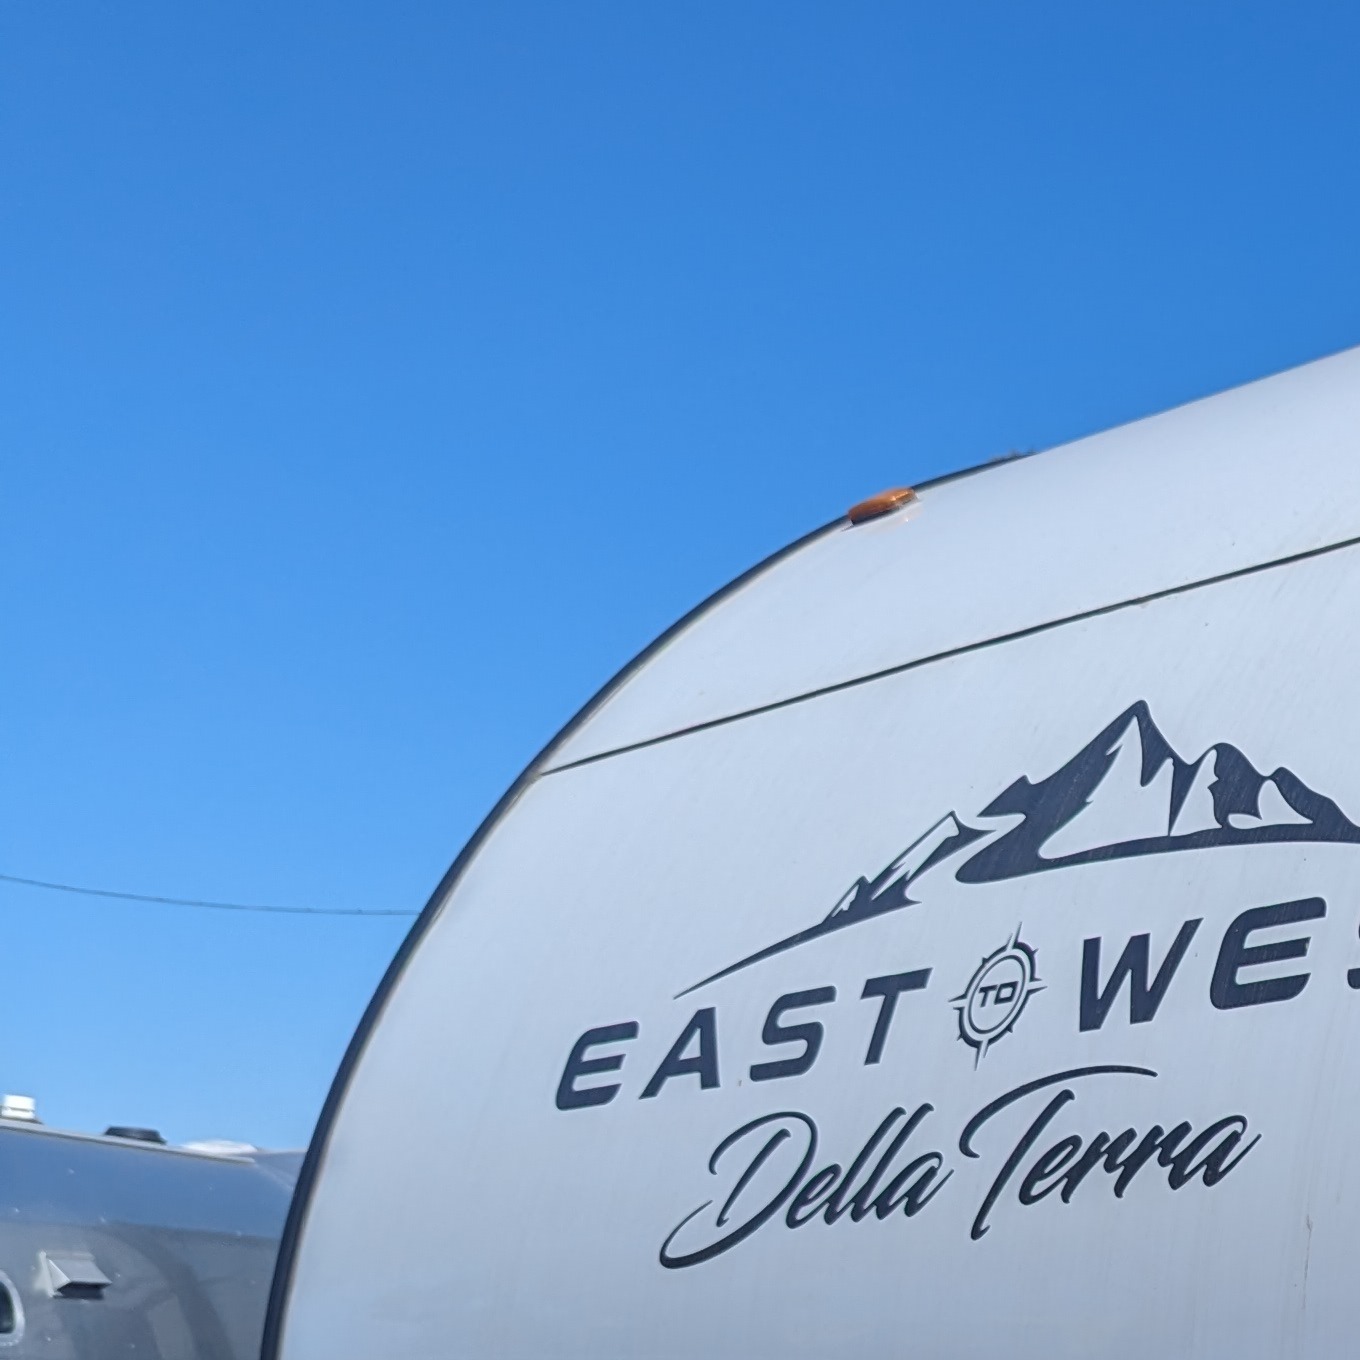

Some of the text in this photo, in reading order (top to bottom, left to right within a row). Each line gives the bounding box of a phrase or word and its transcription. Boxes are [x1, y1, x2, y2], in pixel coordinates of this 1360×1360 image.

[555, 966, 933, 1111] EAST
[978, 980, 1020, 1008] TO
[659, 1063, 1262, 1269] Della Terra
